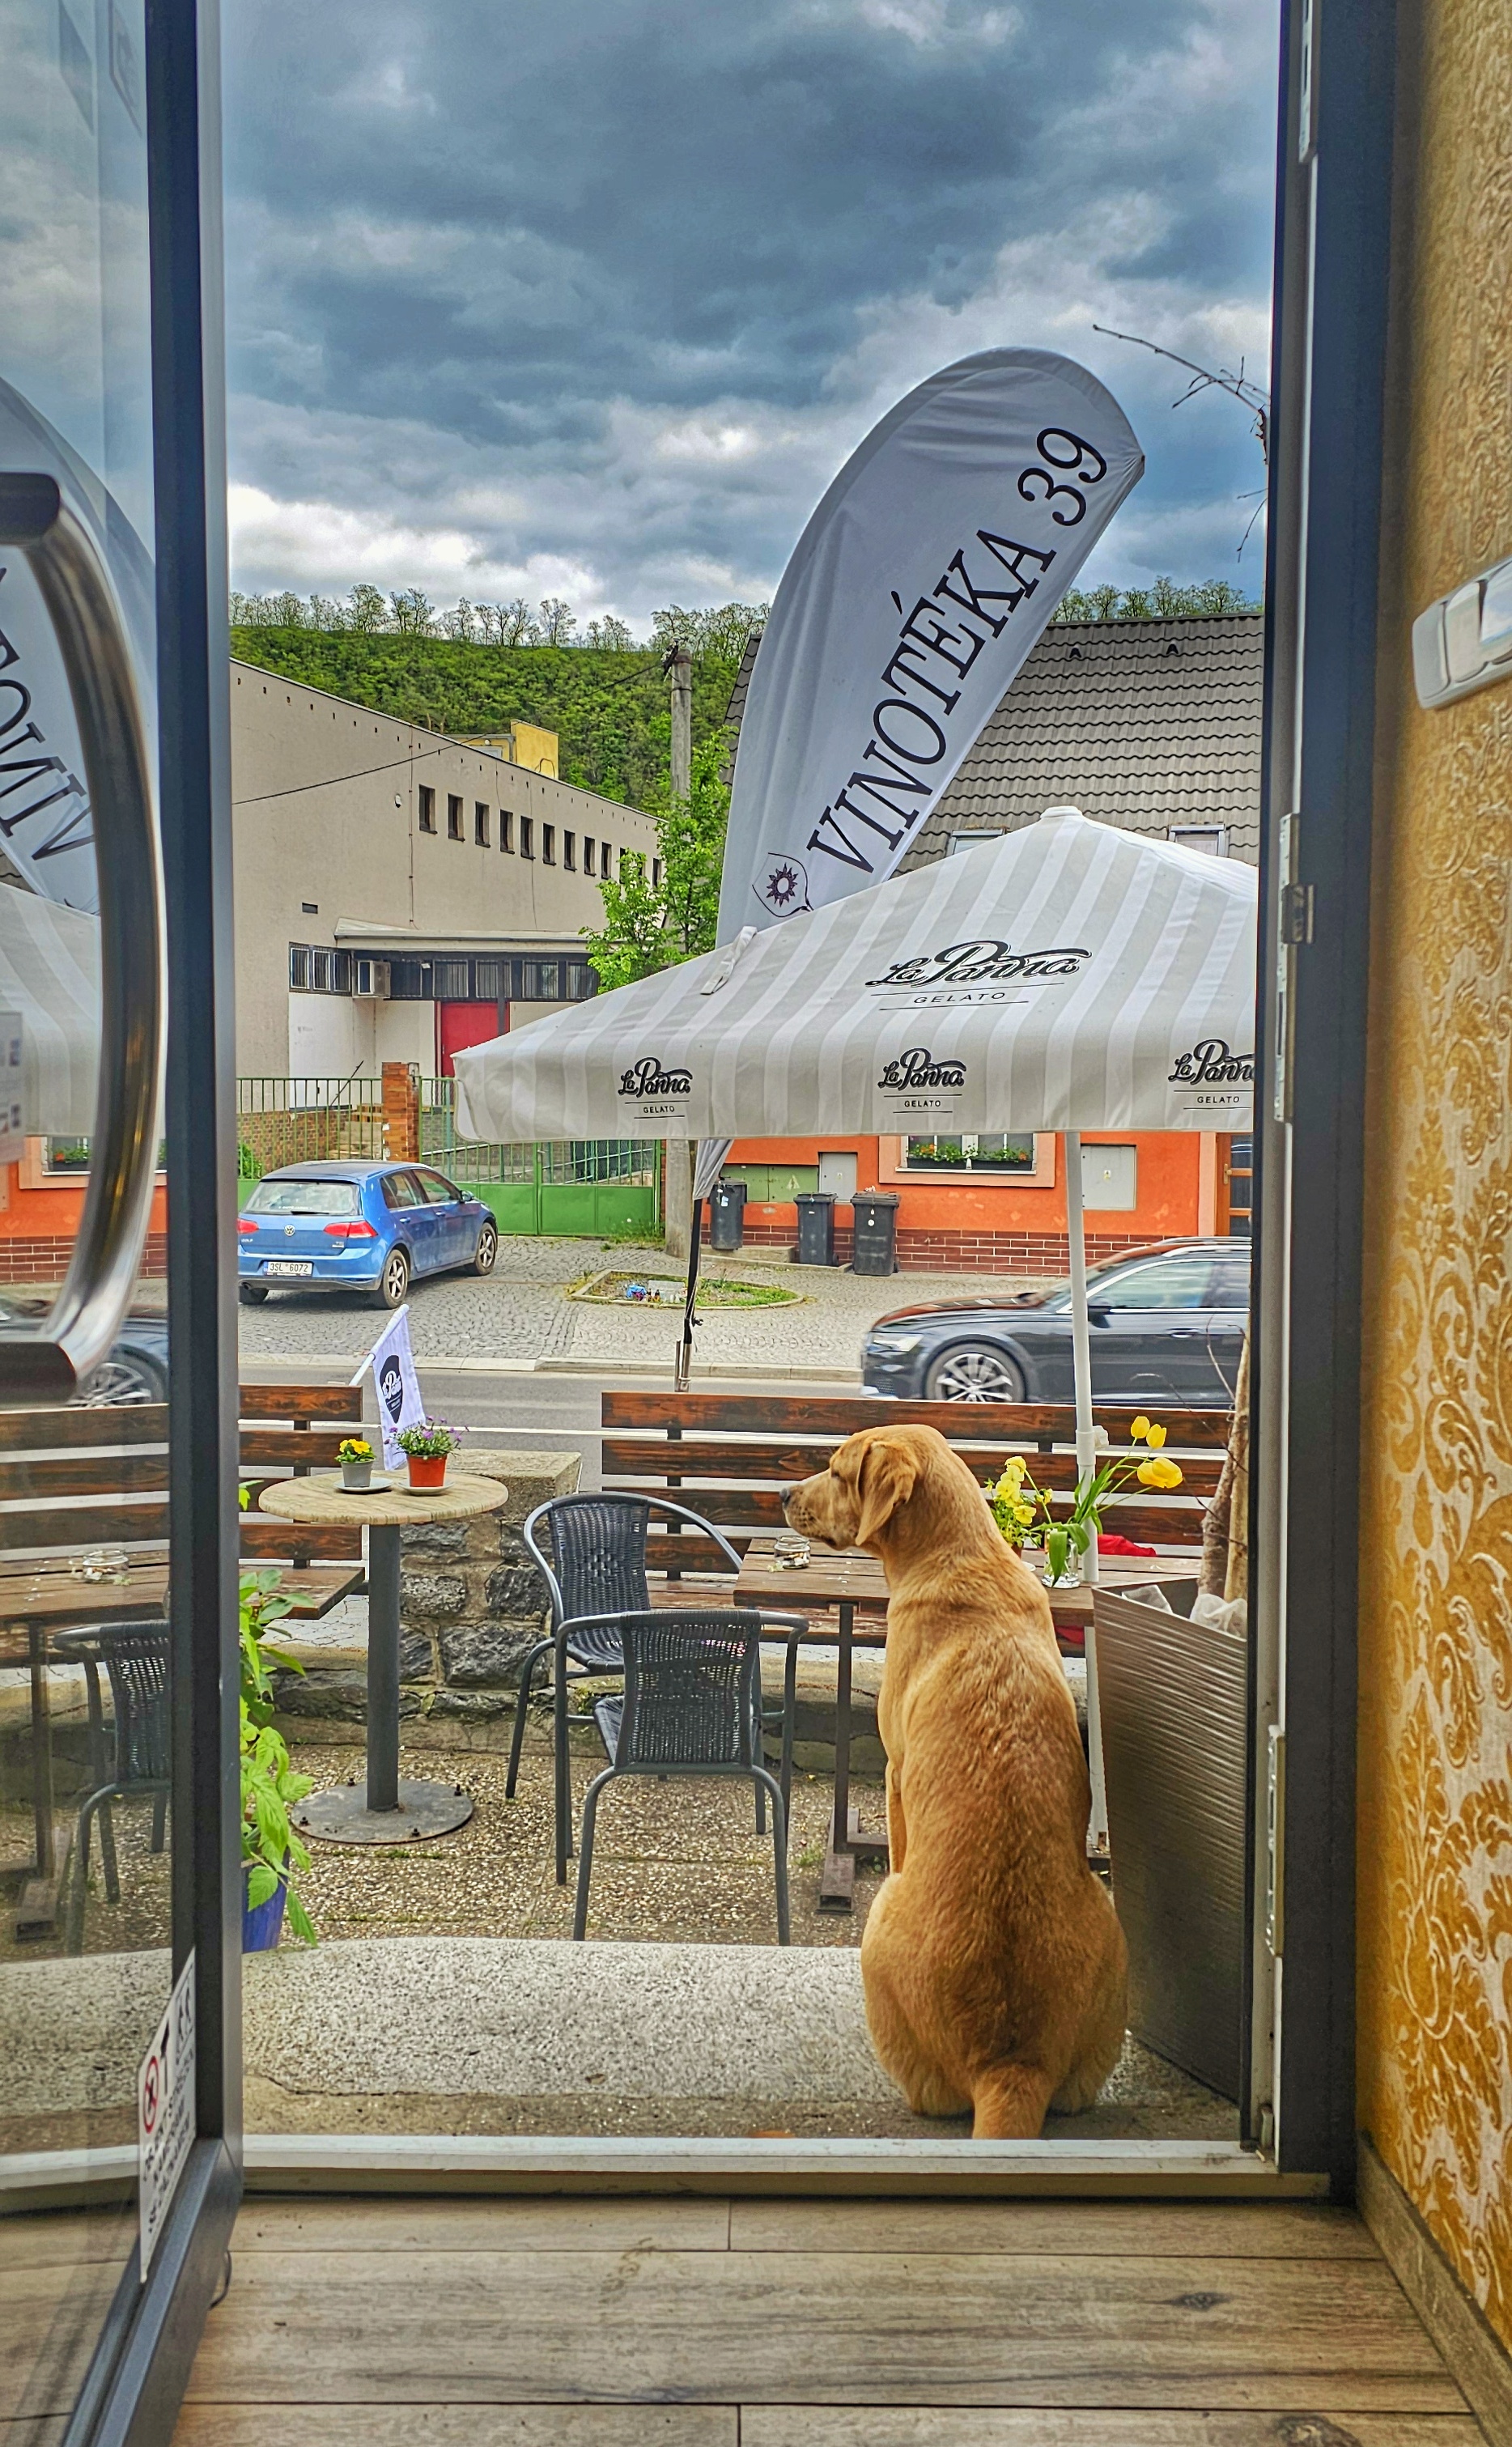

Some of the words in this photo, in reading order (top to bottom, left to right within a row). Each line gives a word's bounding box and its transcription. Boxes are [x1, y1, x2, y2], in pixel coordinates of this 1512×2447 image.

[806, 529, 1057, 873] VINOTÉKA
[1017, 427, 1107, 526] 39
[864, 957, 931, 987] La
[911, 941, 1091, 987] Panna
[914, 992, 1005, 1004] GELATO
[618, 1070, 639, 1095] La
[635, 1057, 693, 1098] Panna
[878, 1061, 902, 1089] La
[898, 1048, 966, 1090] Panna
[1168, 1053, 1196, 1082] La
[643, 1106, 674, 1114] GELATO
[1197, 1096, 1240, 1104] GELATO
[289, 1264, 308, 1272] 6072
